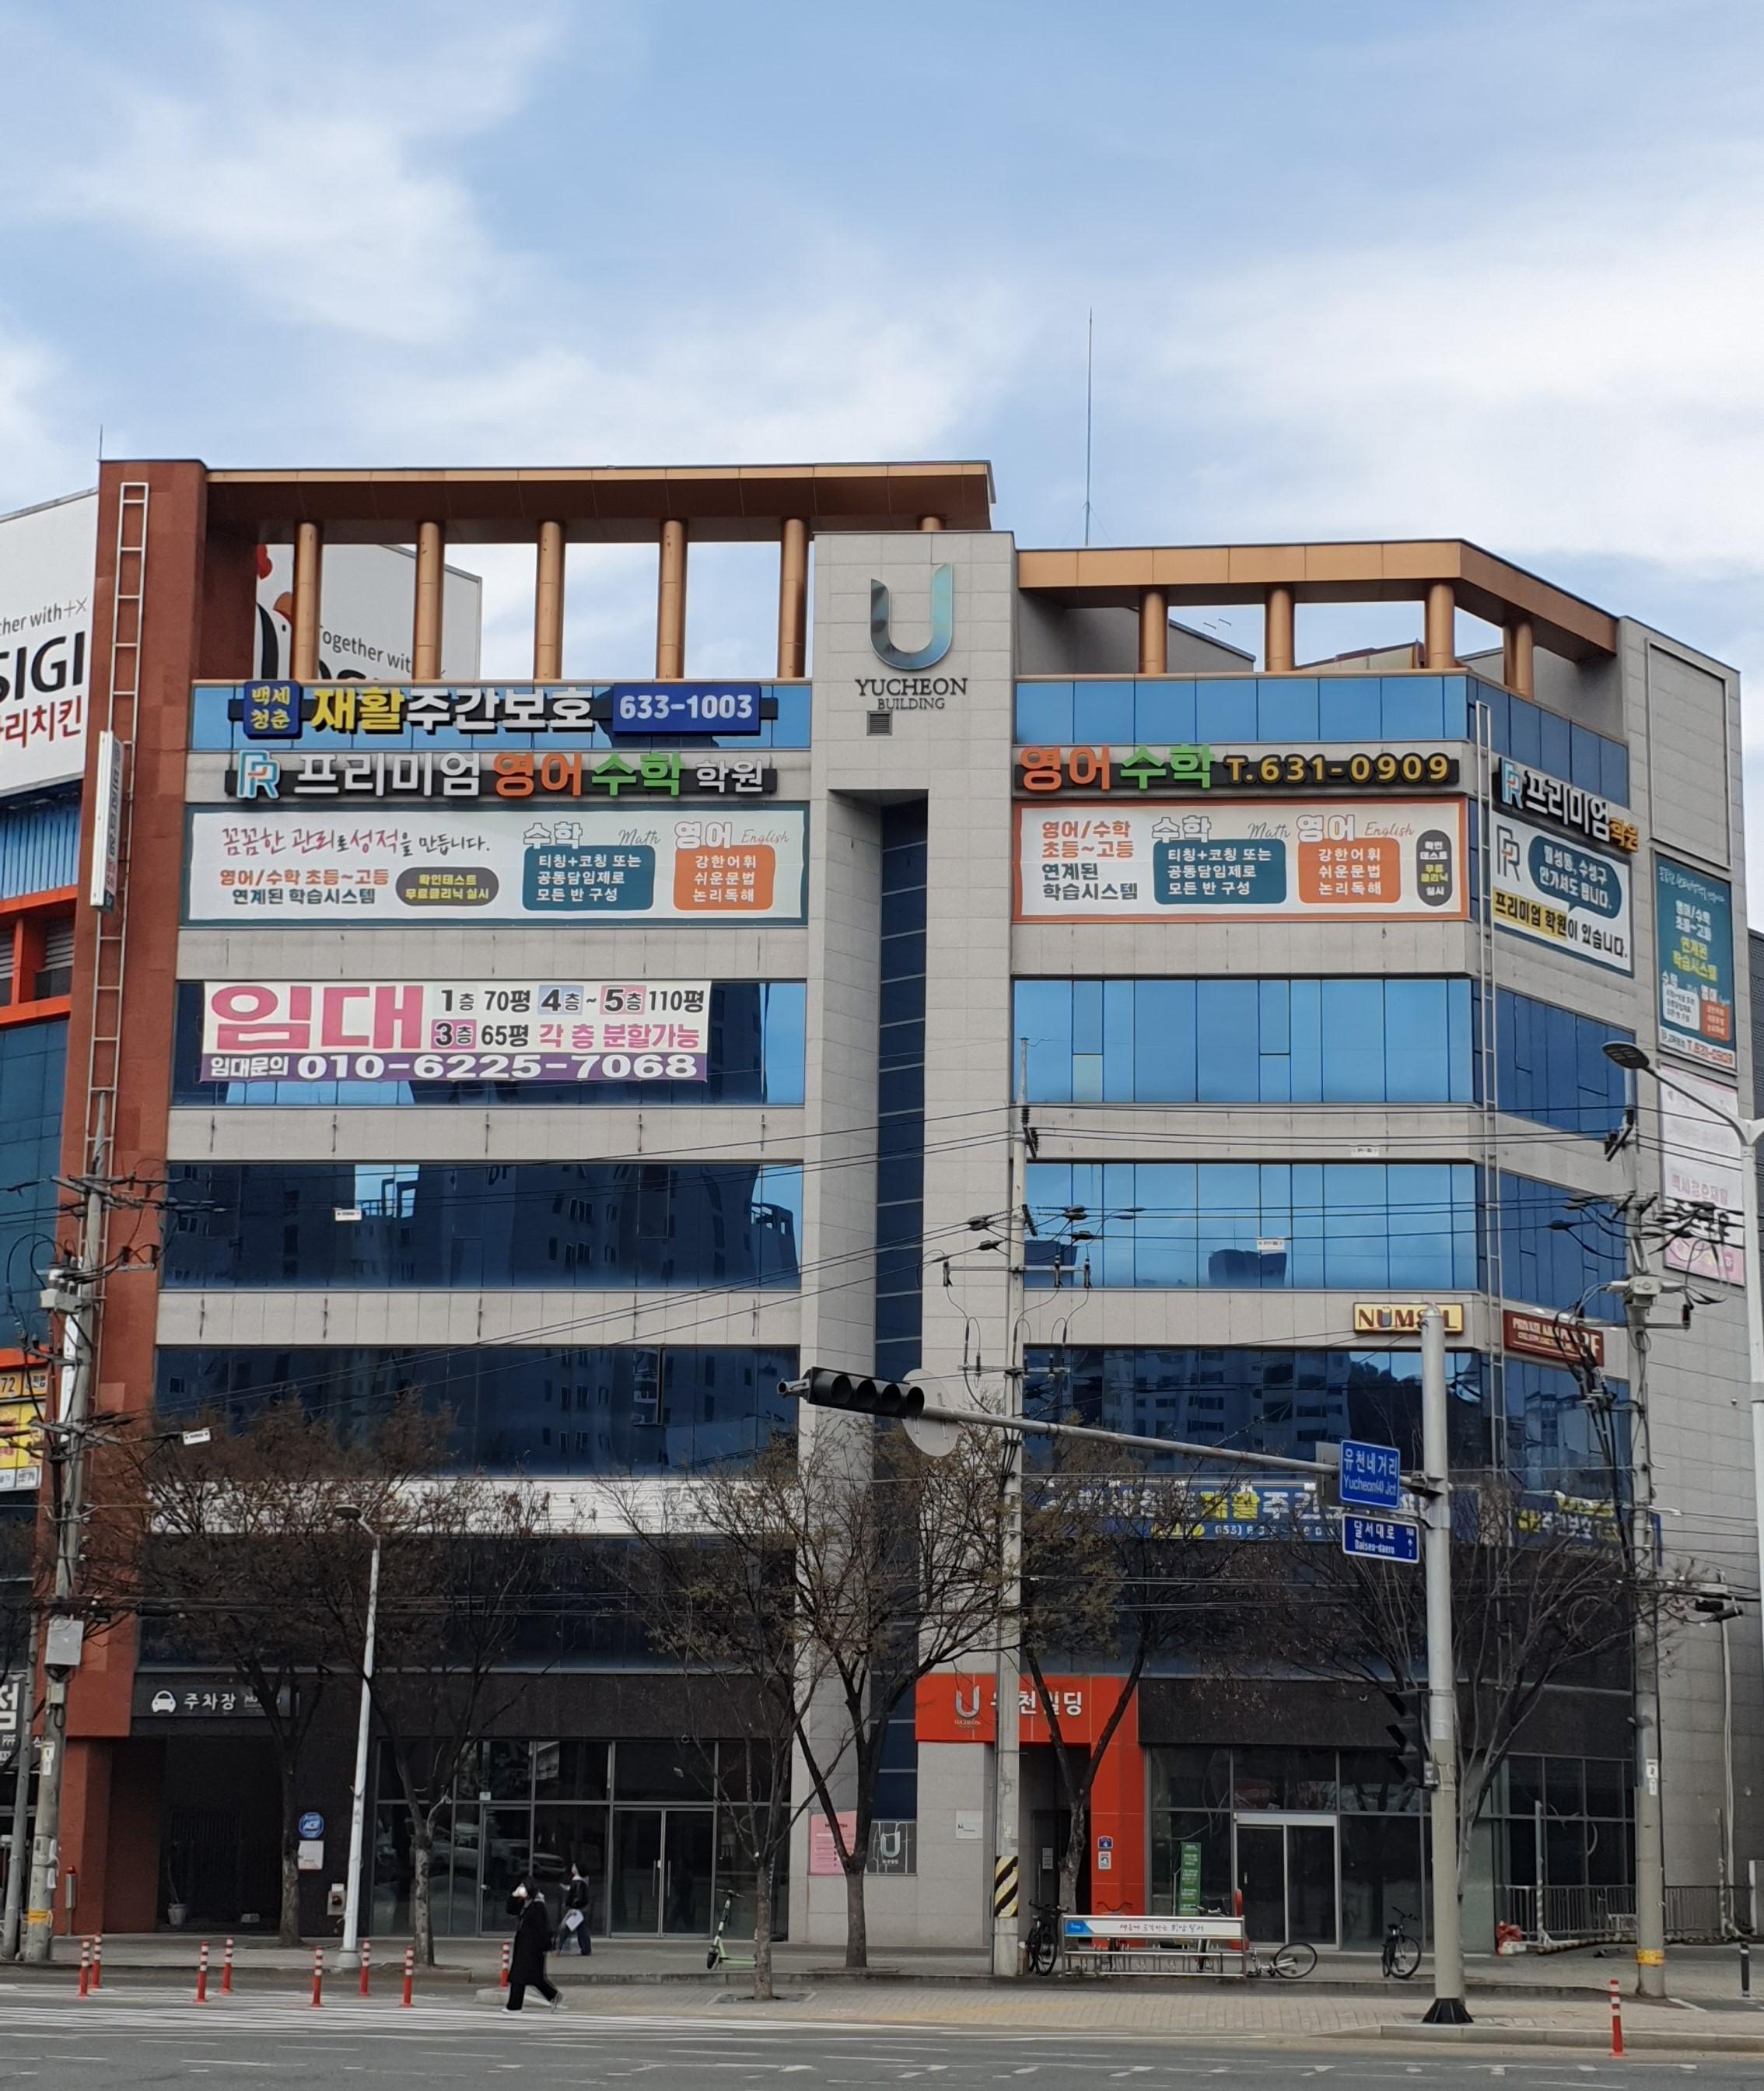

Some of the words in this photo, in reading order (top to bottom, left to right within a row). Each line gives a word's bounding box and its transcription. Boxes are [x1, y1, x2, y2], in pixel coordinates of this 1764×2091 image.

[0, 615, 26, 636] her
[320, 625, 383, 661] ogether
[387, 650, 411, 674] wit
[251, 685, 291, 705] 백세
[855, 678, 968, 696] YUCHEON
[620, 695, 752, 719] 633-1003
[877, 698, 946, 710] BUILDING
[0, 695, 82, 748] 리치킨
[250, 709, 291, 730] 청춘
[294, 752, 480, 797] 프리미엄
[696, 759, 763, 793] 학원
[1226, 755, 1448, 782] T.631-0909
[1525, 770, 1610, 842] 프리미엄
[1610, 817, 1639, 853] 학원
[523, 821, 583, 849] 수학
[618, 829, 660, 846] Math
[674, 821, 733, 849] 영어
[741, 829, 789, 844] English
[1041, 820, 1131, 839] 영어/수학
[1151, 815, 1212, 843] 수학
[1248, 822, 1291, 839] Math
[1296, 814, 1356, 843] 영어
[1364, 821, 1415, 838] English
[222, 827, 285, 856] 꼼꼼한
[418, 836, 490, 856] 만듭니다.
[1041, 841, 1134, 859] 초등~고등
[538, 855, 607, 868] 티칭+코칭
[613, 856, 642, 868] 또는
[1168, 848, 1237, 861] 티칭+코칭
[1243, 848, 1272, 861] 또는
[220, 869, 300, 886] 영어/수학
[418, 874, 477, 885] 확인테스트
[537, 871, 625, 885] 공동담임제로
[1041, 863, 1099, 881] 연계된
[1167, 865, 1256, 878] 공동담임제로
[1579, 859, 1607, 885] 수성구
[233, 888, 284, 905] 연계된
[290, 888, 375, 905] 학습시스템
[466, 888, 489, 900] 실시
[536, 888, 565, 902] 모든
[571, 888, 583, 902] 반
[589, 888, 617, 902] 구성
[1042, 883, 1138, 902] 학습시스템
[1168, 882, 1197, 895] 모든
[1202, 882, 1216, 895] 반
[1222, 882, 1250, 895] 구성
[1496, 891, 1541, 928] 프리미엄
[1582, 923, 1627, 958] 있습니다.
[441, 989, 474, 1012] 1층
[484, 989, 531, 1013] 70평
[649, 989, 704, 1013] 110평
[211, 985, 424, 1050] 임대
[436, 1022, 472, 1046] 3층
[481, 1024, 529, 1048] 65평
[603, 1023, 699, 1049] 분할가능
[210, 1056, 289, 1078] 임대문의
[297, 1054, 697, 1079] 010-6225-7068
[1359, 1307, 1458, 1328] NÜMSL
[1343, 1448, 1398, 1477] 유천네거리
[1354, 1520, 1395, 1539] 달서대로
[1355, 1539, 1395, 1554] Dalseo-daero
[184, 1693, 236, 1711] 주차장
